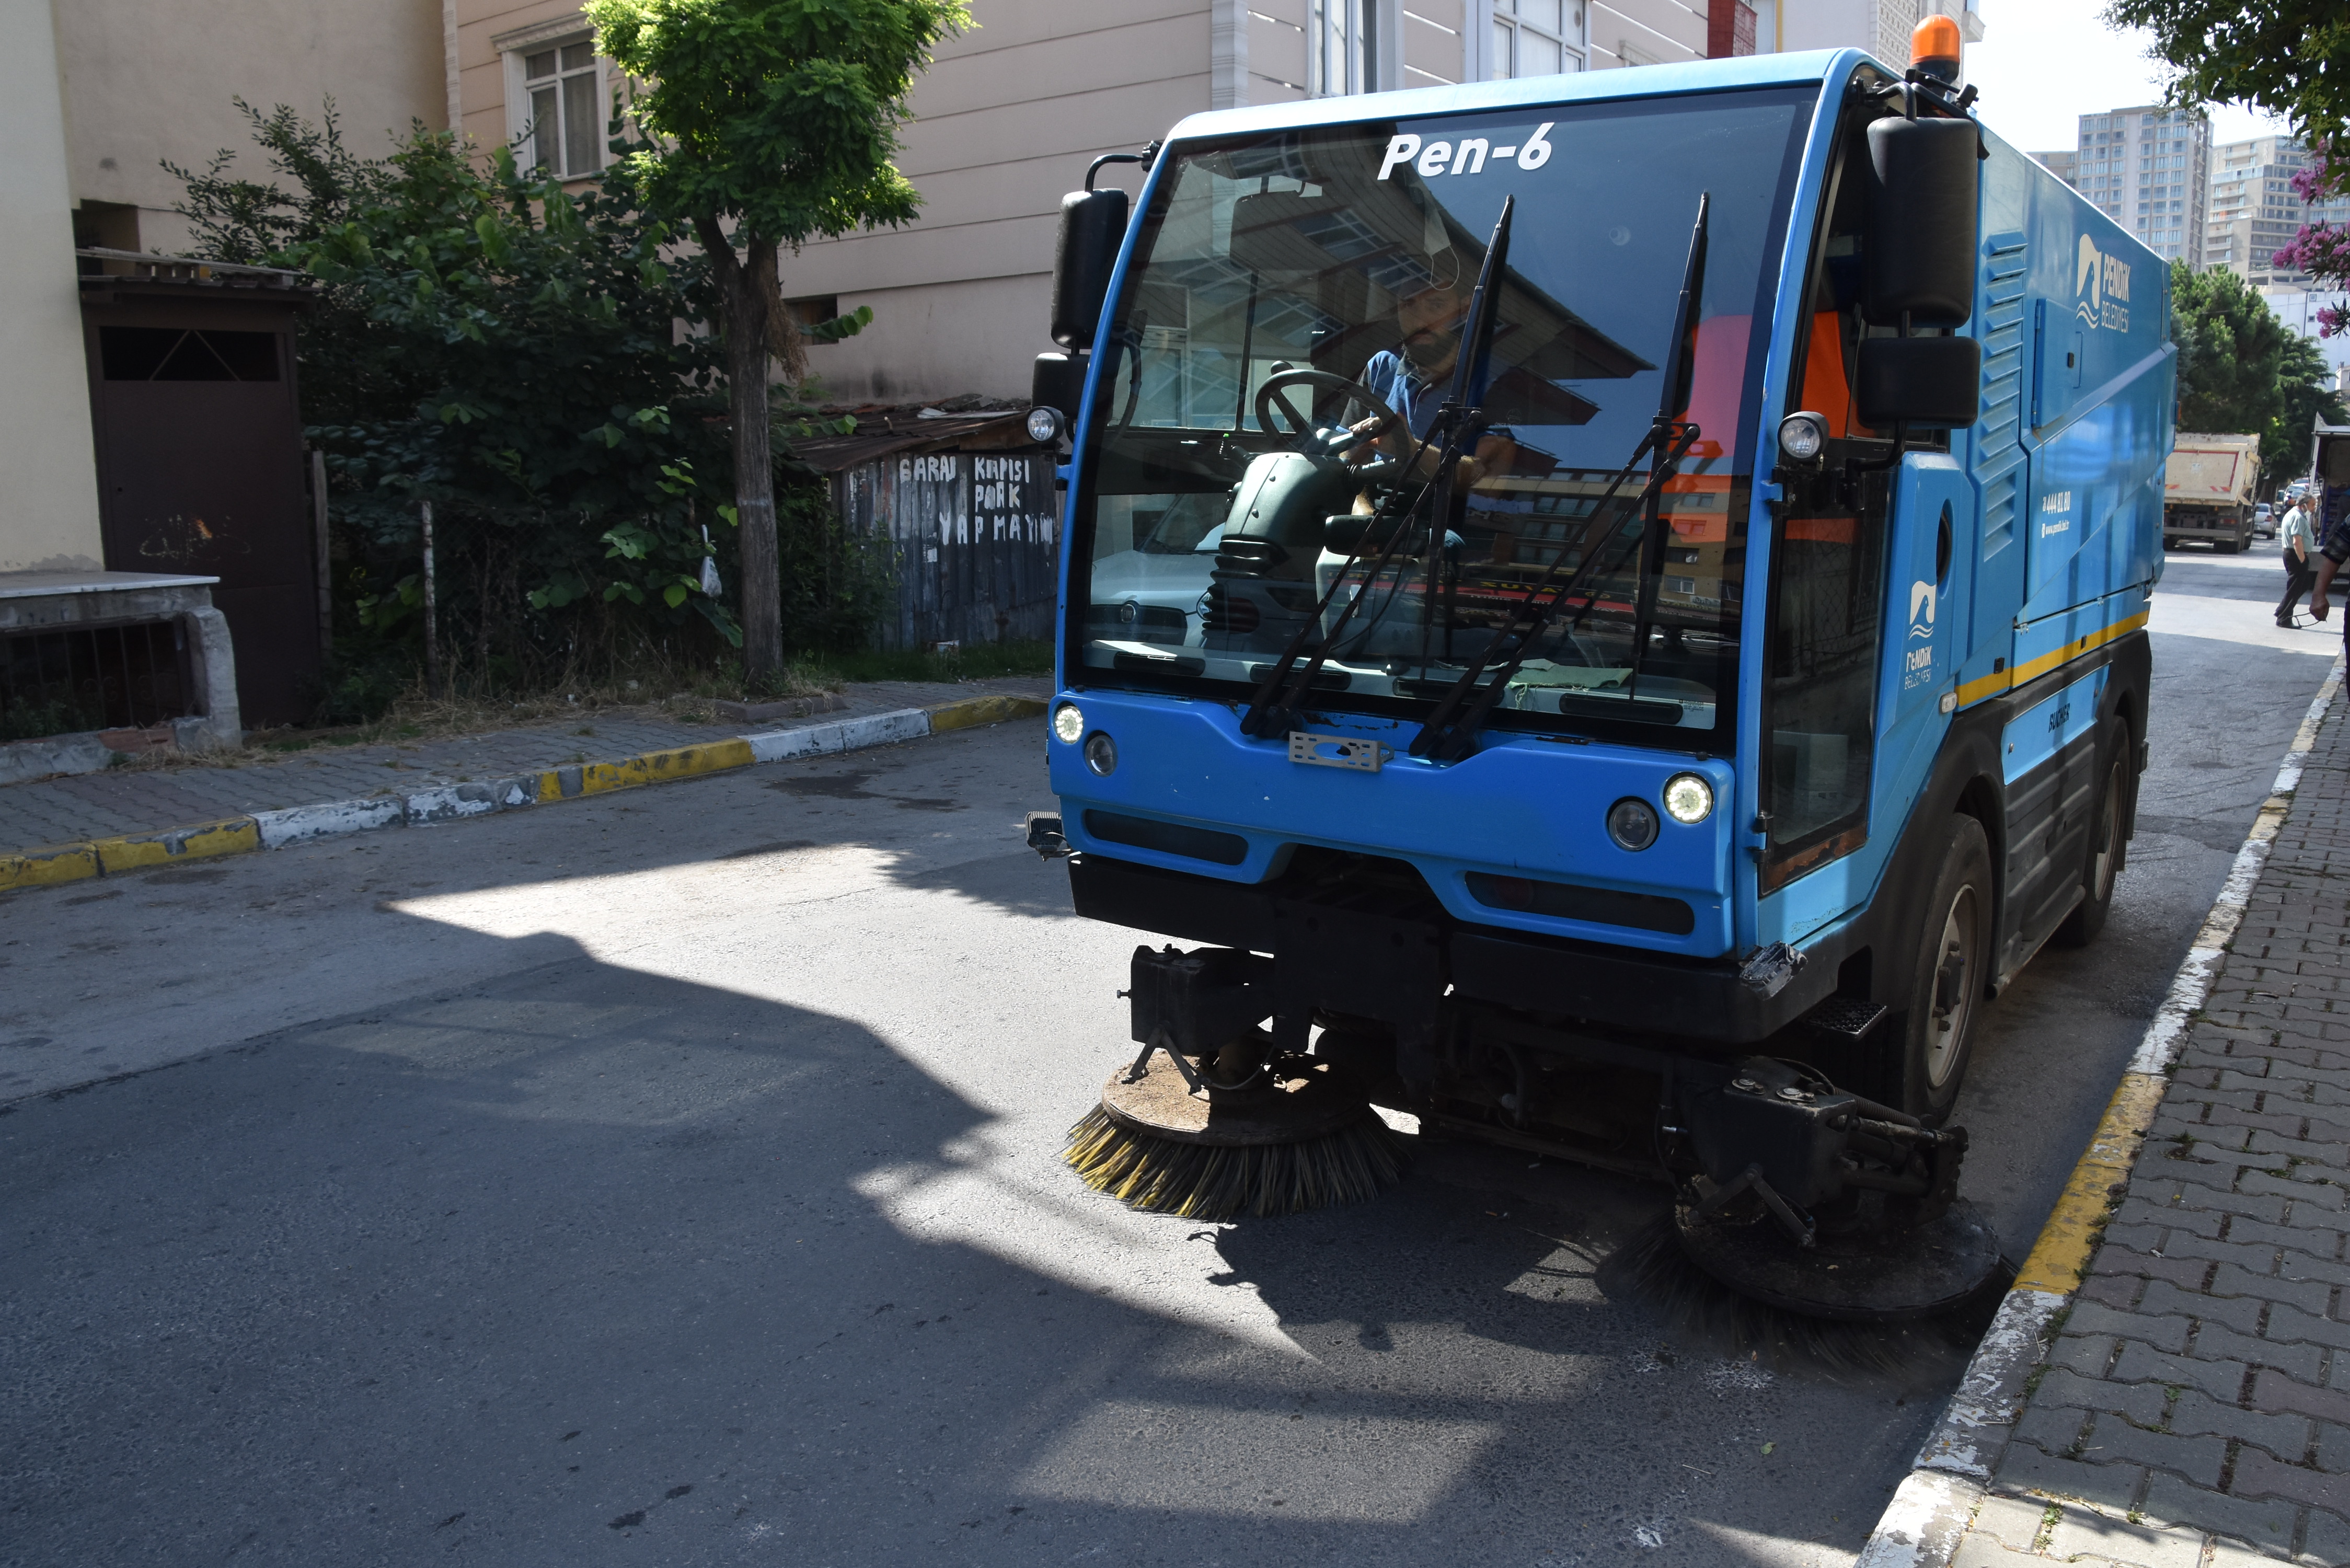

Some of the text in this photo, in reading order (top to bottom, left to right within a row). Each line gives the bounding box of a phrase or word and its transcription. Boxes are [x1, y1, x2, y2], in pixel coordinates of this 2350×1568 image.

[1377, 122, 1555, 180] Pen-6
[975, 481, 1020, 512] PARK
[2046, 491, 2070, 515] 444 81 80
[2048, 702, 2070, 733] BUCHER
